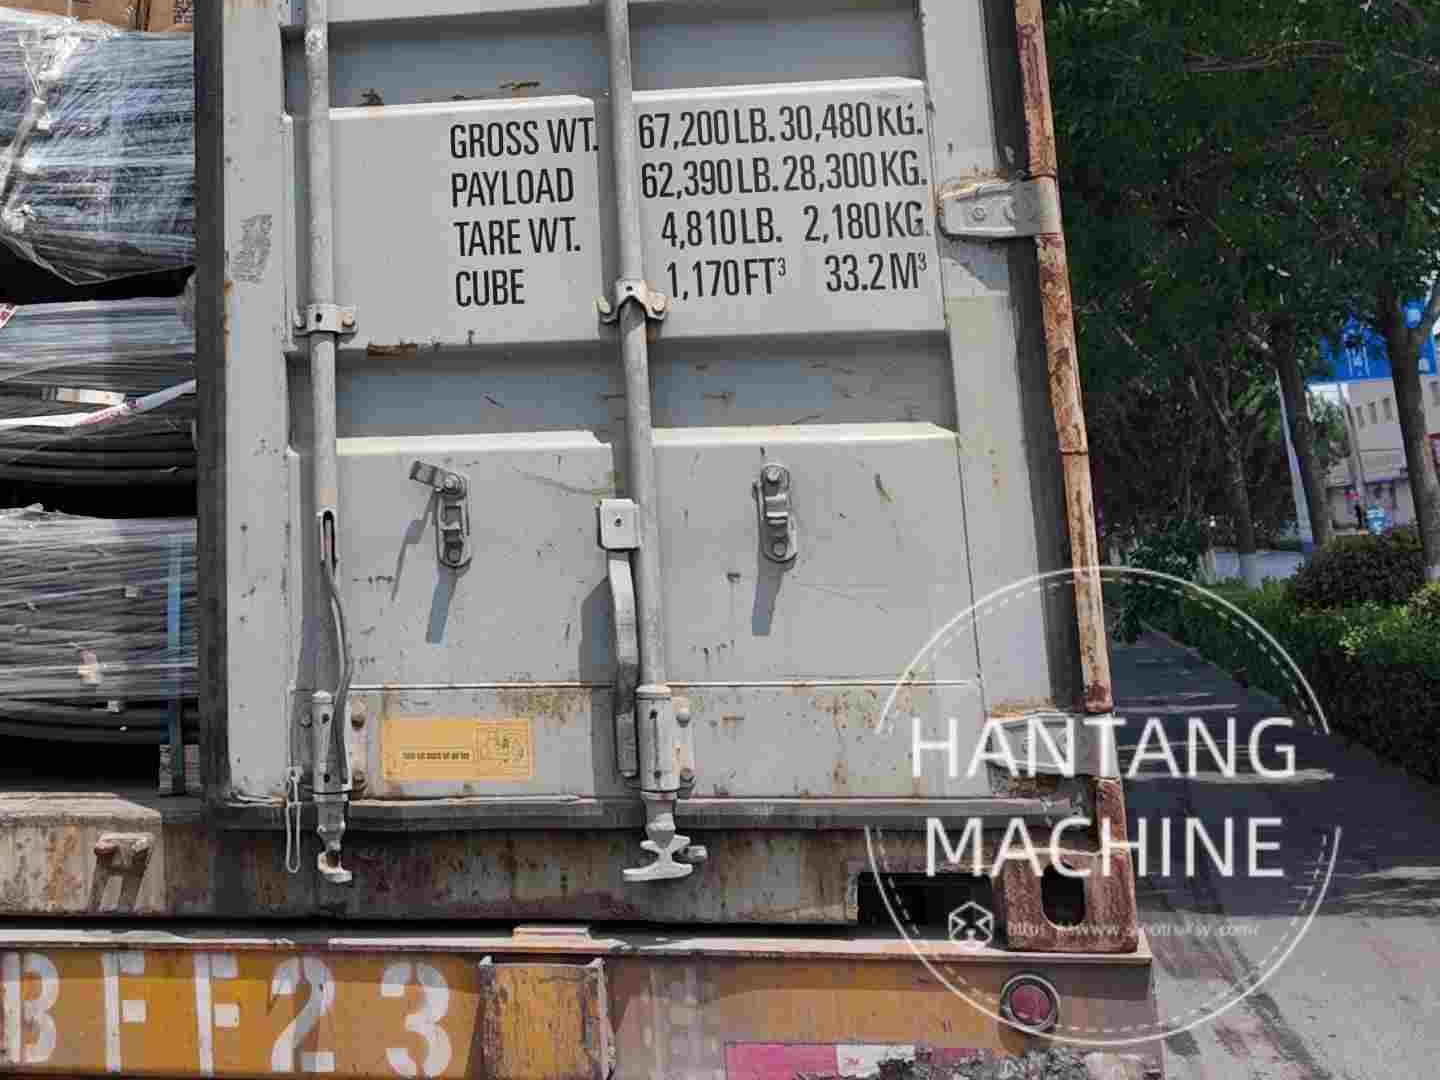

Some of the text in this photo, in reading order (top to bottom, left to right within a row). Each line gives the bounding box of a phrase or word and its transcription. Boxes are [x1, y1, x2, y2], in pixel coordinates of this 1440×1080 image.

[450, 120, 540, 159] GROSS
[546, 117, 599, 154] WT.
[451, 167, 574, 208] PAYLOAD
[453, 219, 522, 257] TARE
[528, 216, 581, 254] WT.
[455, 268, 525, 308] CUBE
